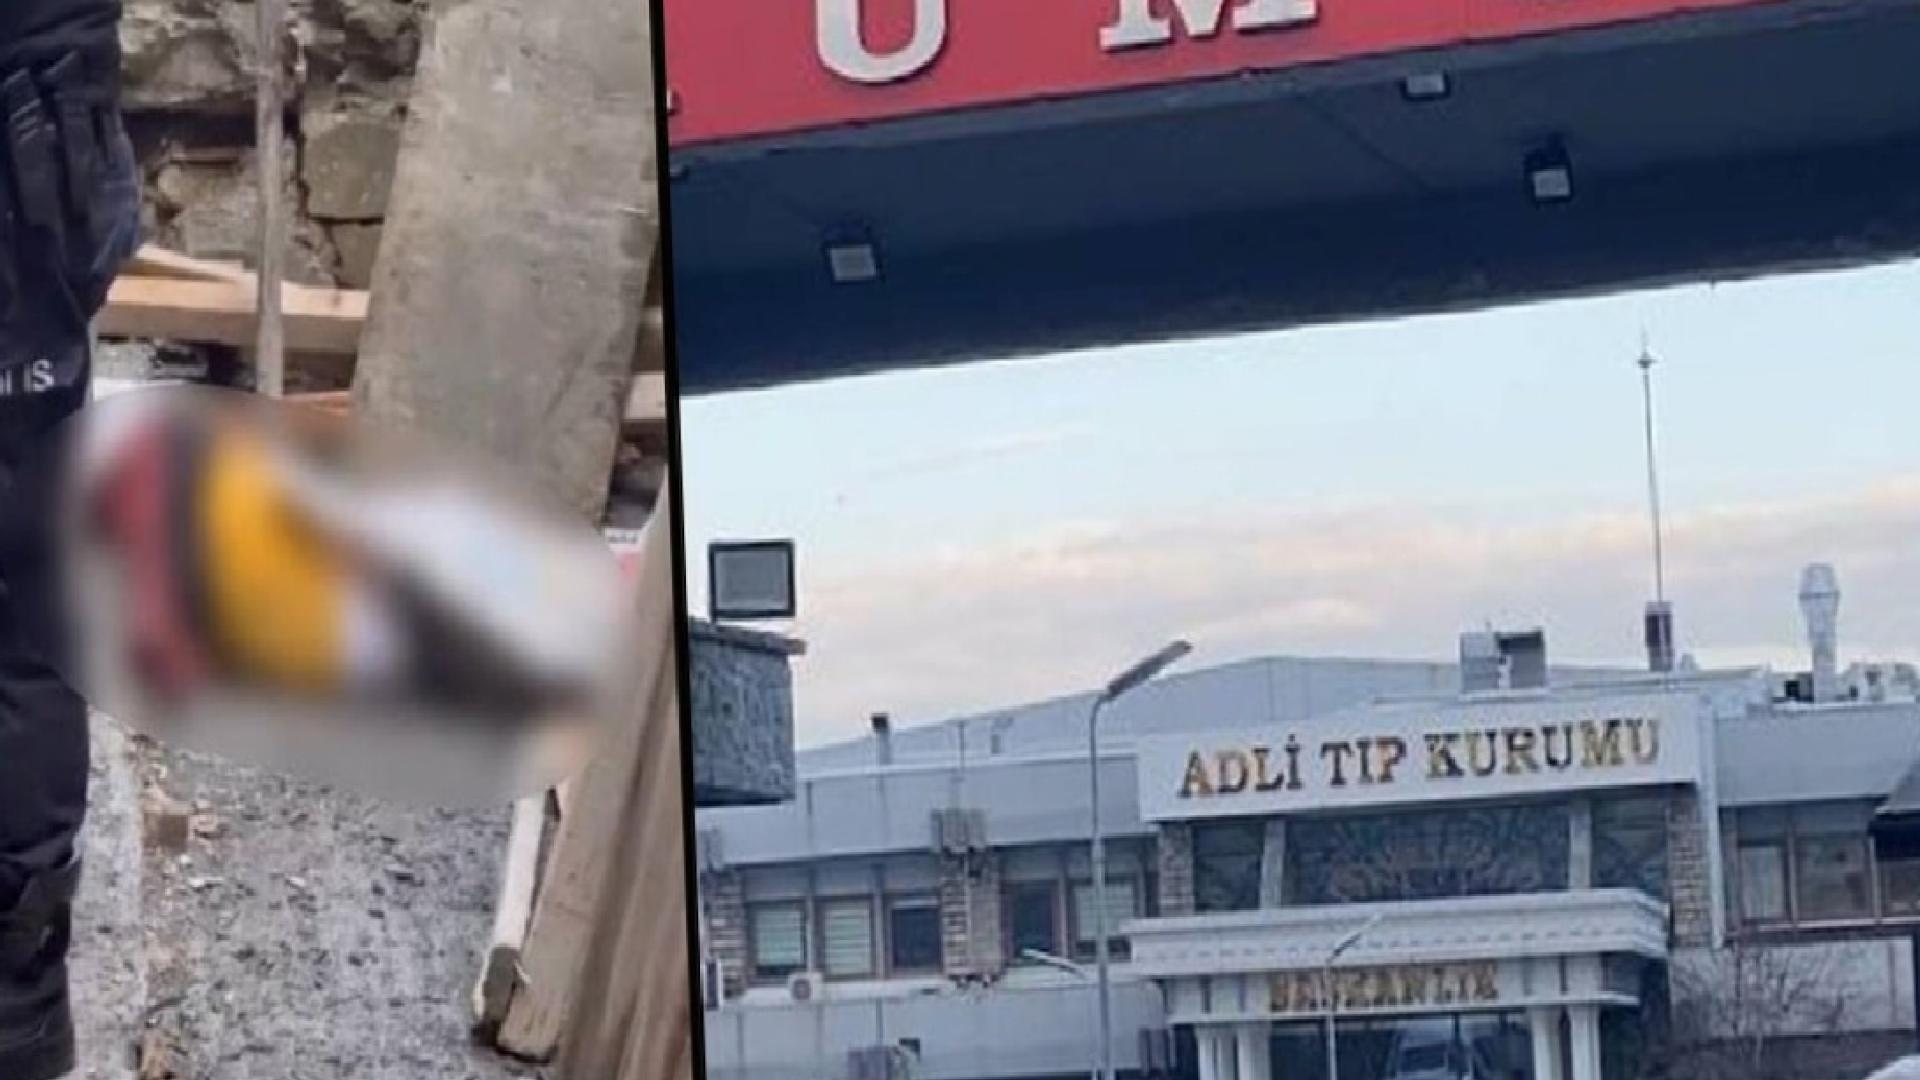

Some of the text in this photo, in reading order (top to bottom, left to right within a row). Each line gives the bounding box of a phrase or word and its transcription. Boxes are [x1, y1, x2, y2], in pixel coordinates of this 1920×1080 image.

[1178, 719, 1661, 799] ADLİ TIP KURUMU
